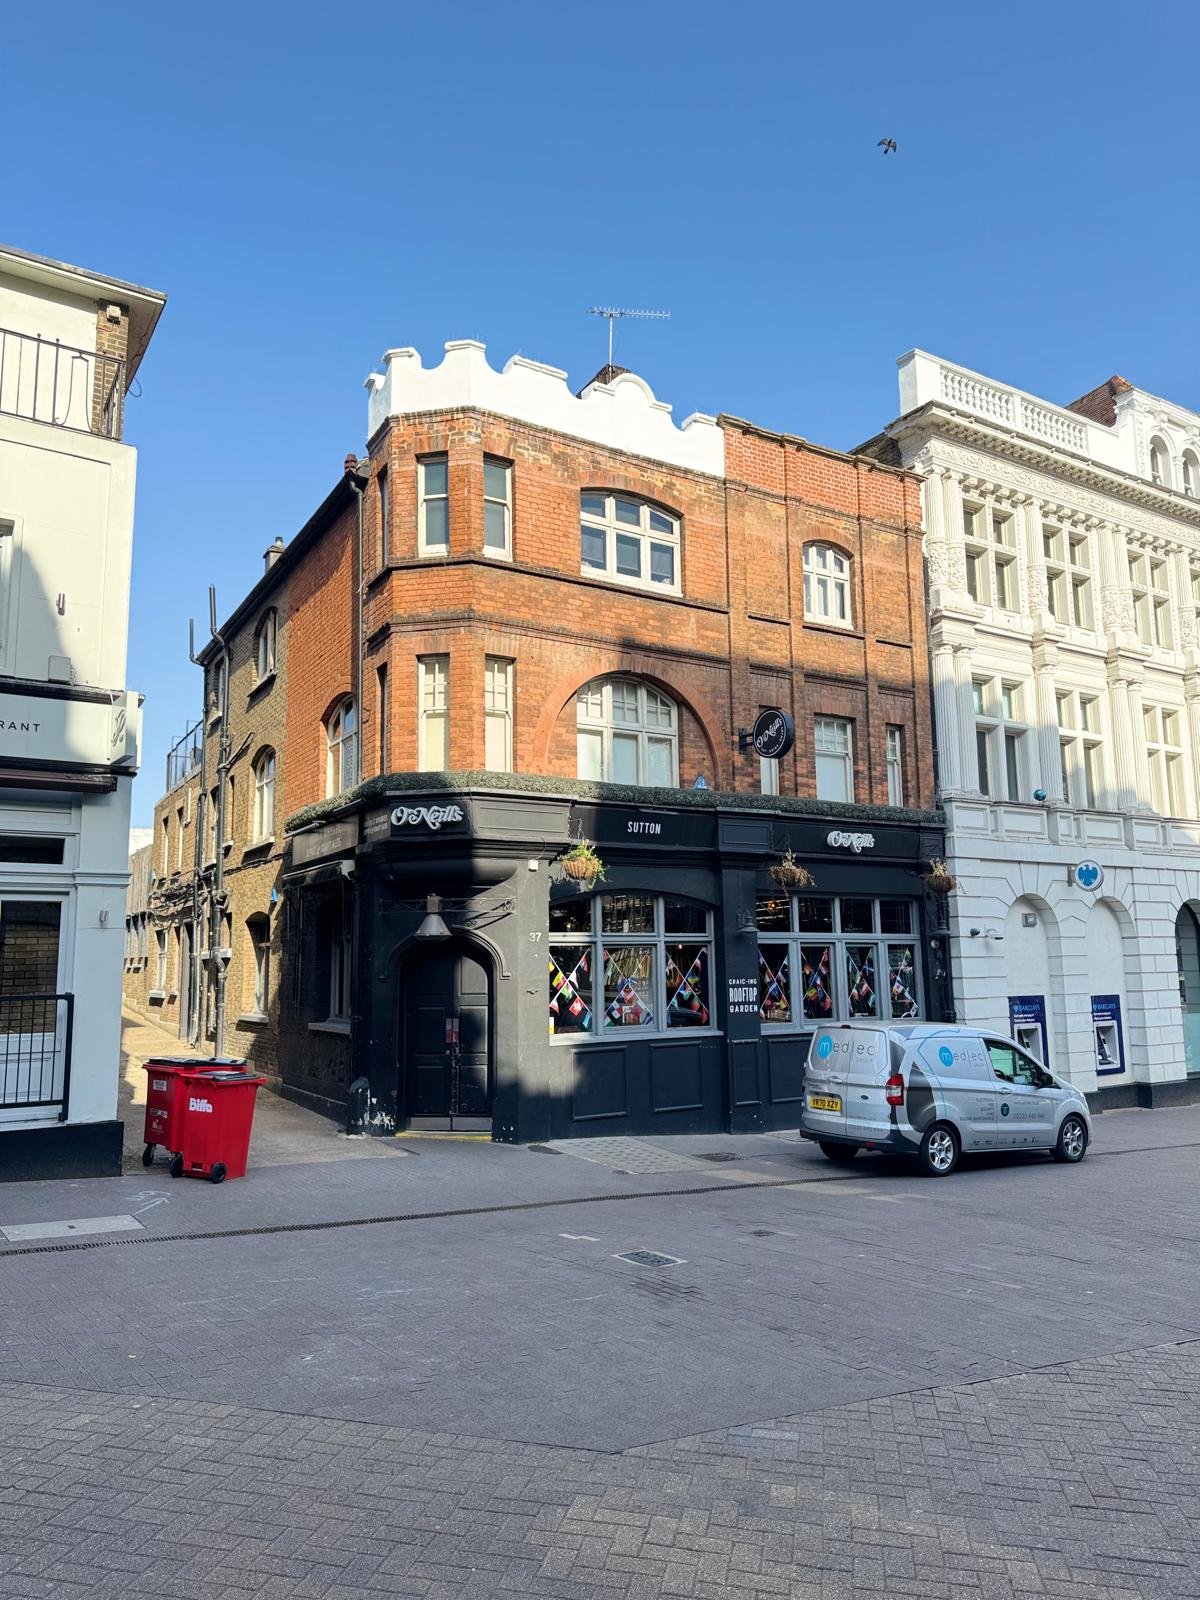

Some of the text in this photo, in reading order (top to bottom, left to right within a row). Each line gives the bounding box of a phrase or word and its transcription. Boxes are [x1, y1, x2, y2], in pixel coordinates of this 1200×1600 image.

[627, 820, 662, 835] SUTTON
[529, 932, 542, 943] 37
[729, 987, 758, 1002] ROOFTOP
[729, 1004, 759, 1013] GARDEN
